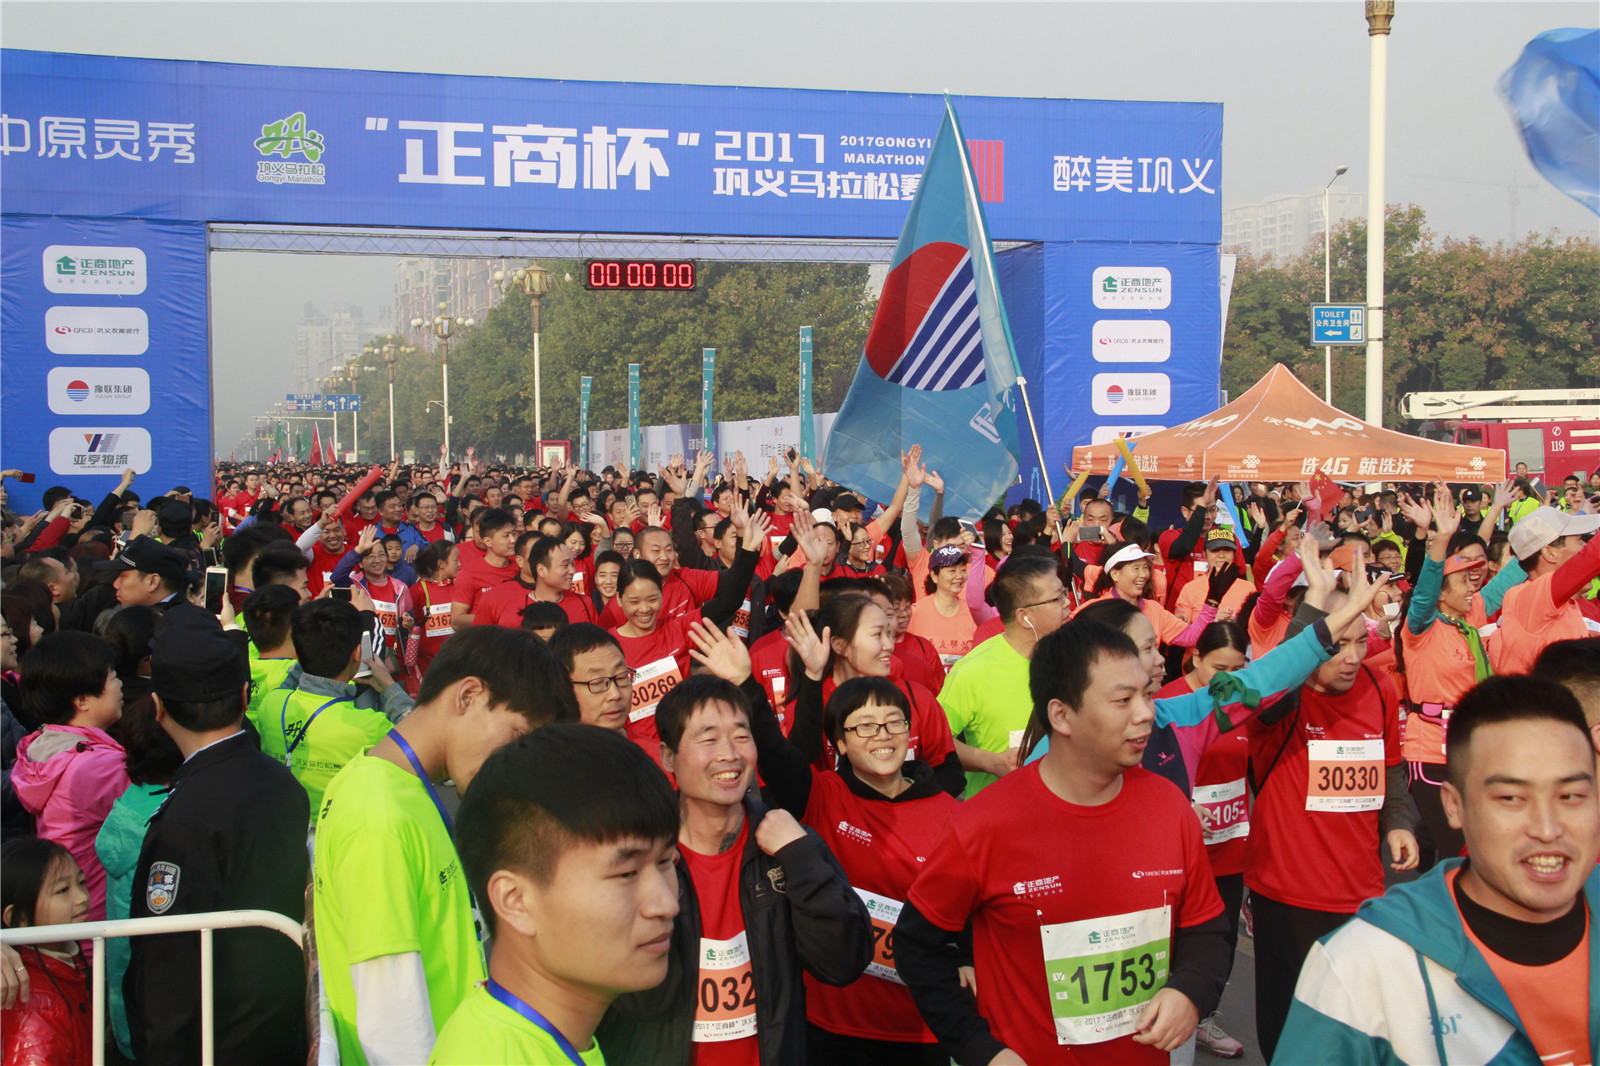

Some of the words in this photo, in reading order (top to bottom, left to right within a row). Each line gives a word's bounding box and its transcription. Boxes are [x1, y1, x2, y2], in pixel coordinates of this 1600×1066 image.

[0, 113, 195, 164] 中原灵秀
[840, 134, 931, 149] 2017GONGYI
[715, 130, 824, 164] 2017
[844, 152, 925, 166] MARATHON
[258, 162, 324, 176] 巩义马拉松
[1053, 155, 1215, 195] 醉美巩义
[258, 174, 286, 183] Gongyi
[287, 175, 324, 183] Marathon
[80, 258, 134, 269] 正商地产
[591, 262, 620, 287] 00
[627, 263, 656, 287] 00
[663, 263, 692, 287] 00
[1121, 277, 1162, 287] 正商地产
[1315, 319, 1350, 327] 公共卫生间
[1550, 440, 1565, 452] 119
[1301, 457, 1351, 475] 选4G
[1357, 456, 1416, 475] 就选沃
[1318, 765, 1378, 791] 30330
[1027, 875, 1060, 888] 正商地产
[1028, 882, 1062, 893] ZENSUN
[1103, 925, 1135, 938] 正商地产
[1104, 932, 1136, 943] ZENSUN
[1070, 953, 1156, 1005] 1753
[1084, 1016, 1101, 1026] 2017
